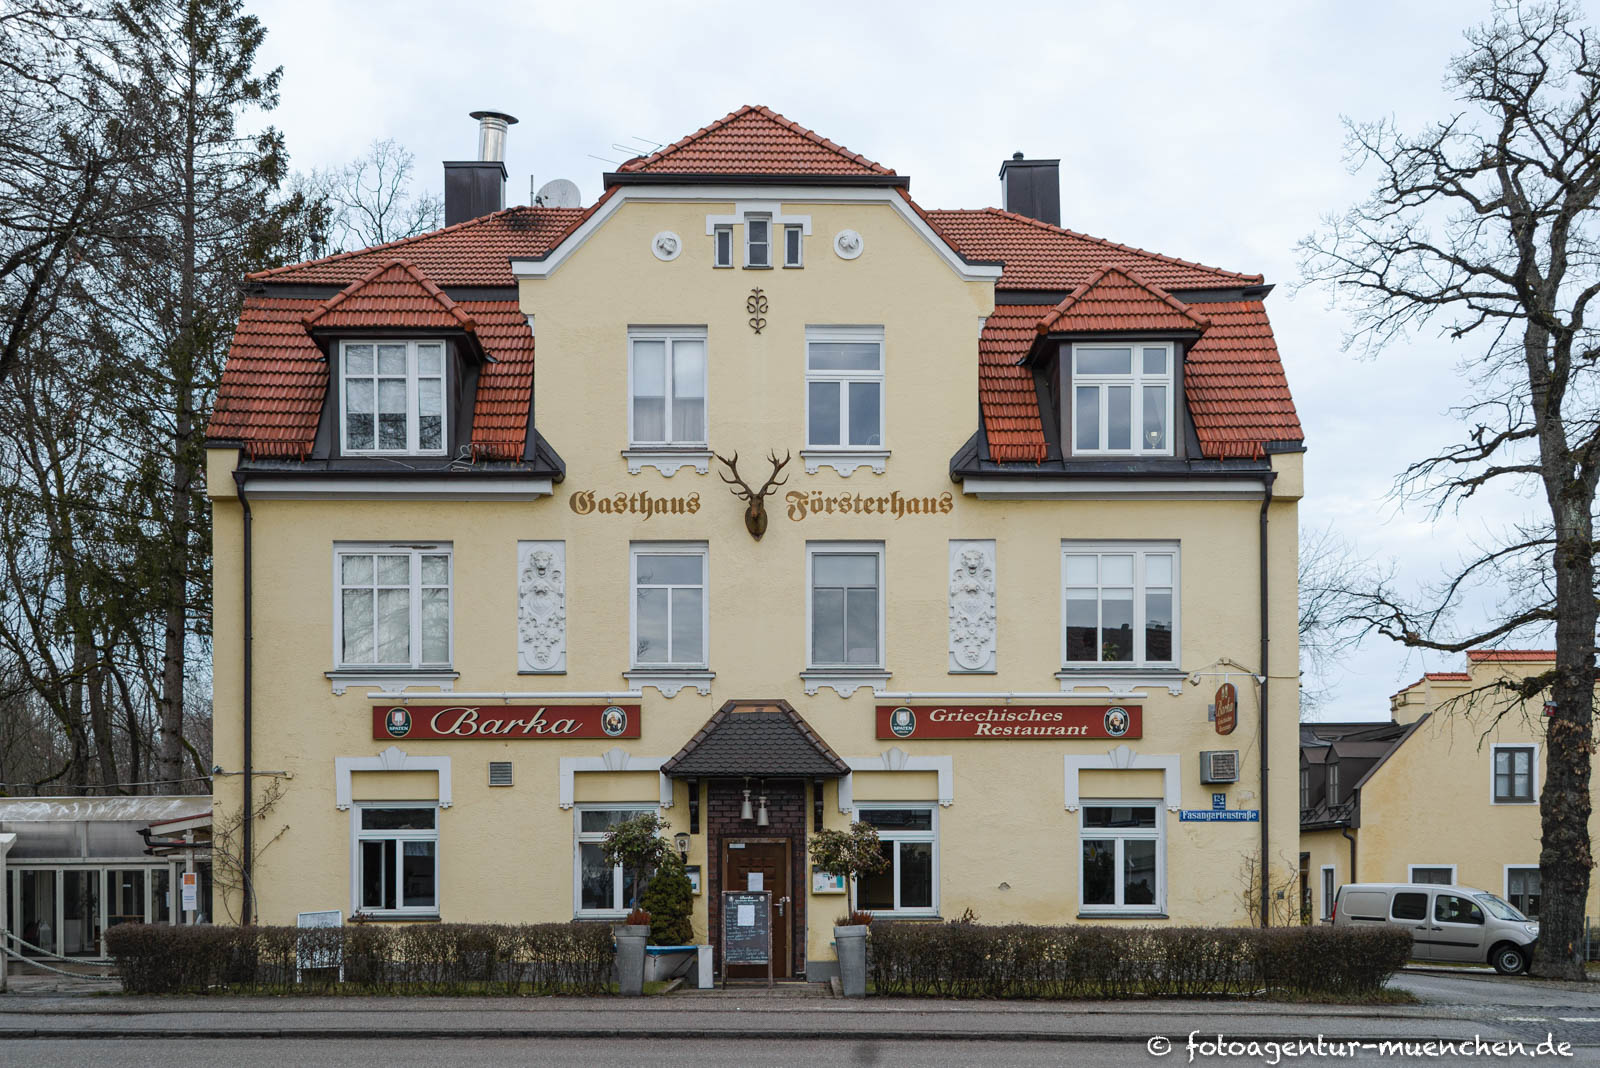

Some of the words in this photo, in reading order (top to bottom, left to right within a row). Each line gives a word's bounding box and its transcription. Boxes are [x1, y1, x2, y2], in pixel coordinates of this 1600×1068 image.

[569, 490, 701, 521] Gasthaus
[785, 490, 954, 522] Försterhaus
[430, 707, 583, 736] Barka
[929, 708, 1063, 722] Griechisches
[974, 723, 1088, 736] Restaurant
[1182, 810, 1257, 821] Fasangartenstraße
